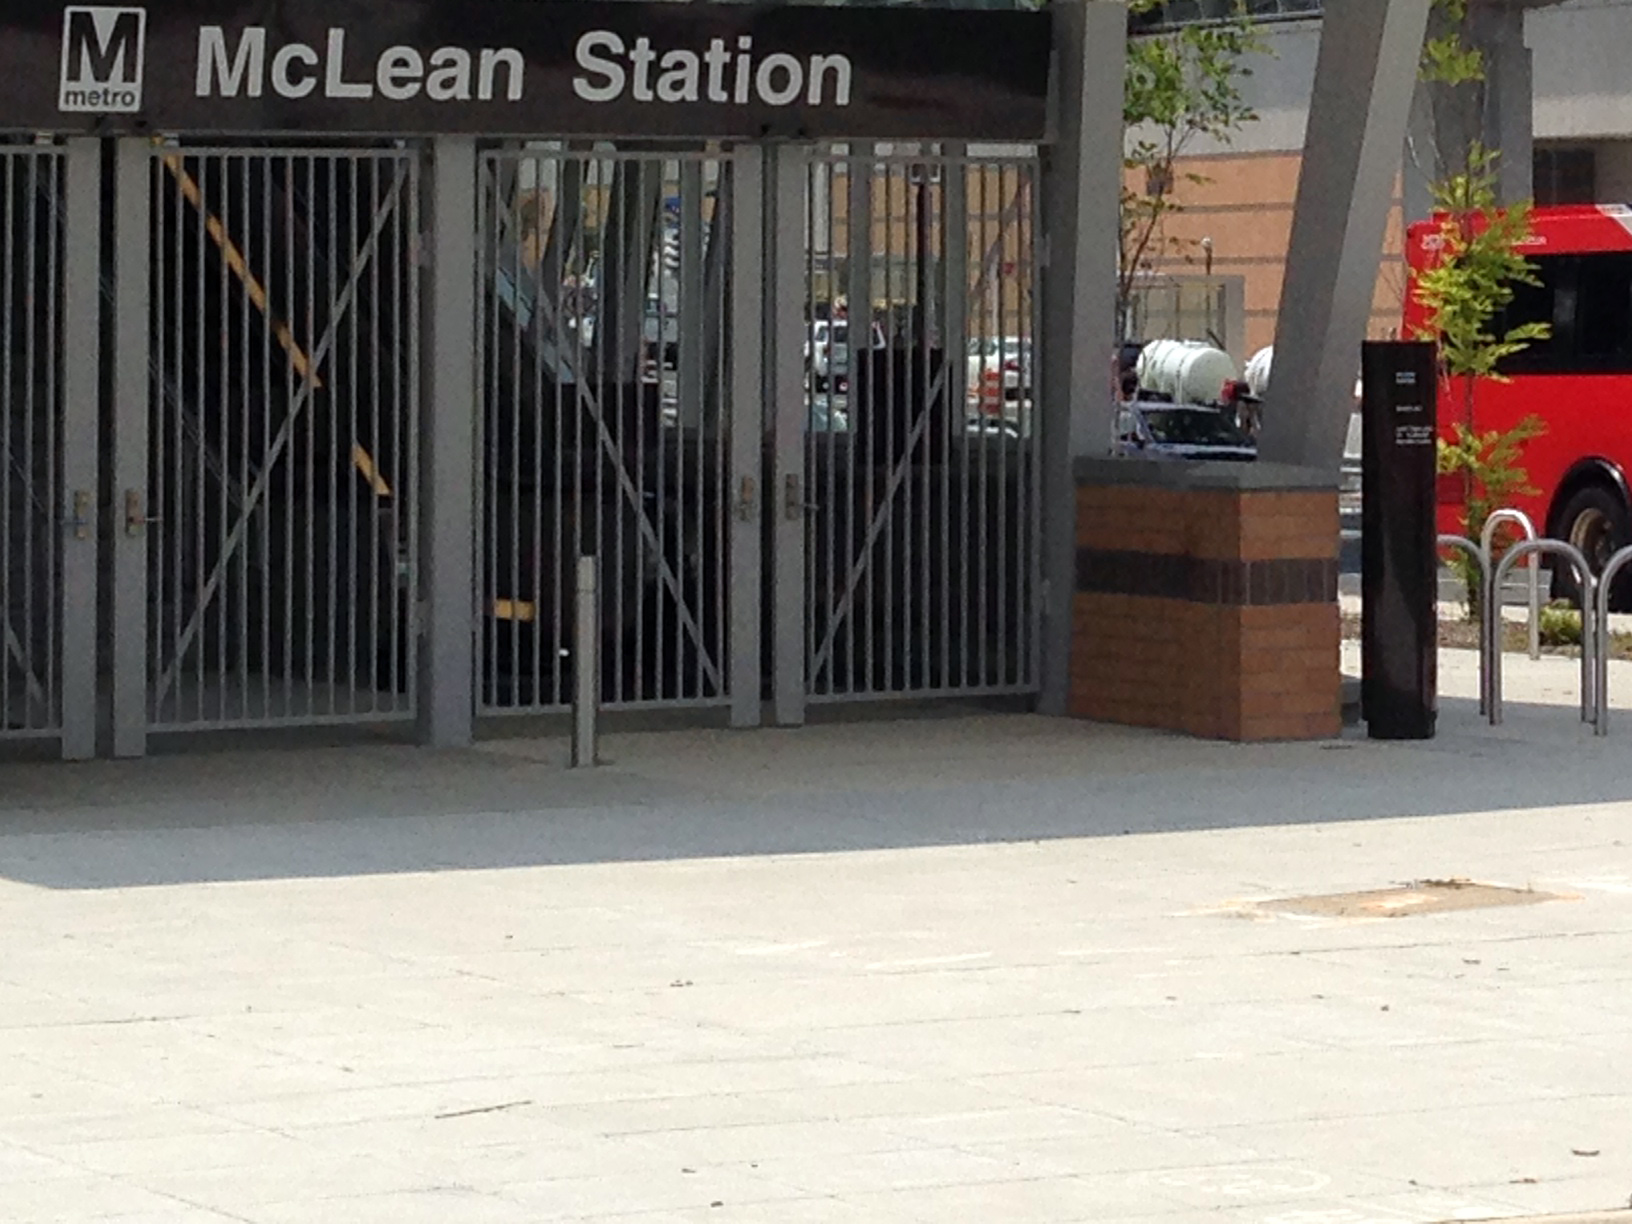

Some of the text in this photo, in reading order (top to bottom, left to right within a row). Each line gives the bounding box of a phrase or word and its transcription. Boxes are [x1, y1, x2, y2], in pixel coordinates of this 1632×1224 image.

[66, 11, 139, 83] M
[194, 25, 852, 107] McLean Station
[64, 87, 136, 107] metro
